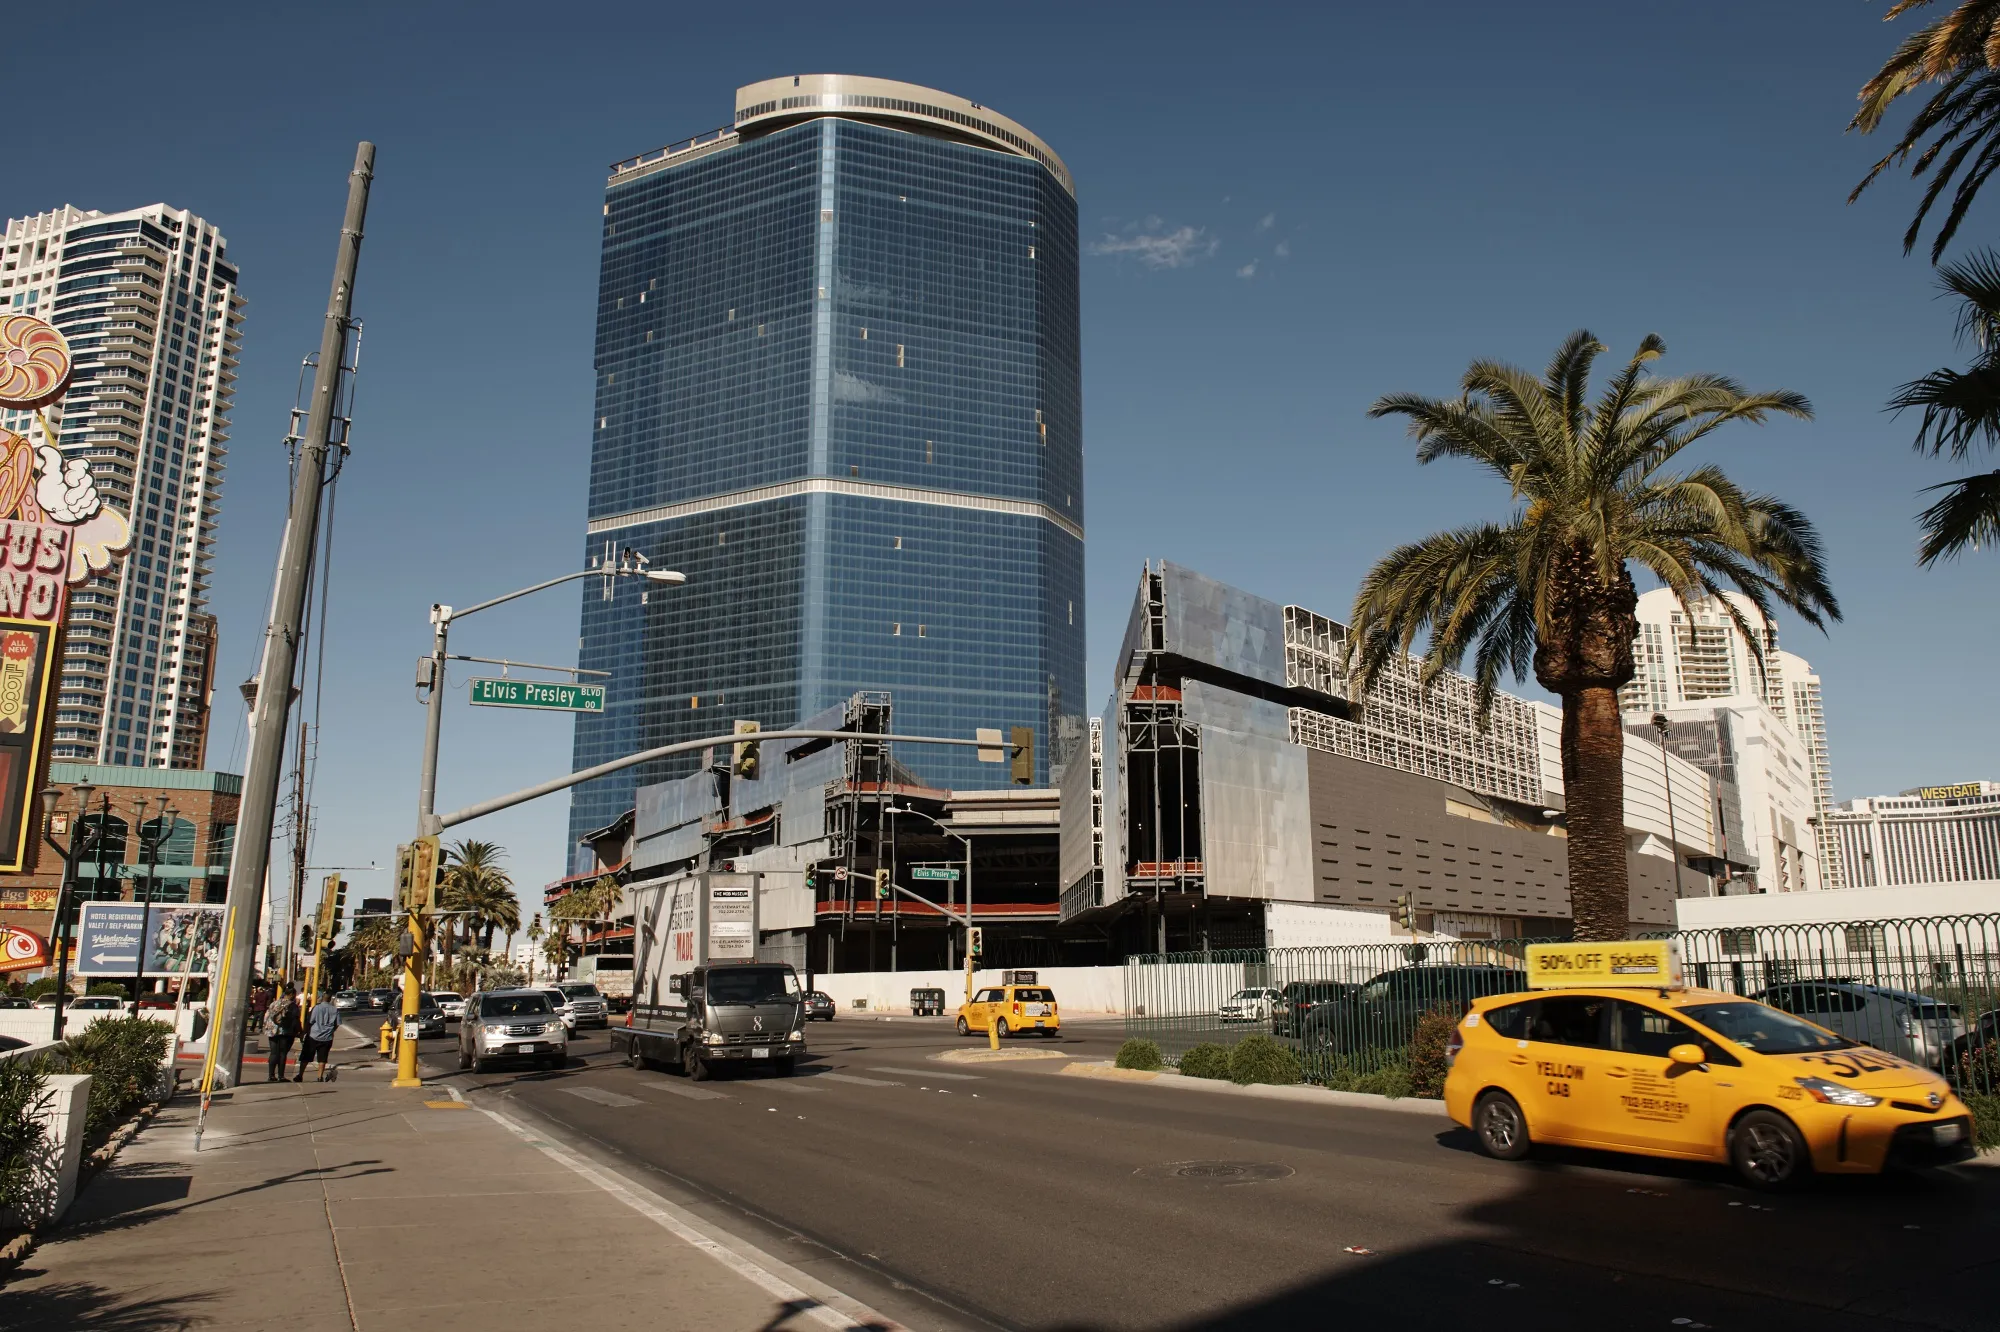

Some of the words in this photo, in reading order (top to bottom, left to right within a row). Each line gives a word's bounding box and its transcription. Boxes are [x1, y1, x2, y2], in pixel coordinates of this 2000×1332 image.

[474, 680, 480, 689] E
[483, 681, 517, 699] Elvis
[525, 684, 575, 707] Presley
[581, 687, 601, 697] BLVD
[1920, 783, 1981, 800] WESTGATE
[917, 869, 930, 877] Elvis
[931, 869, 949, 878] Presley
[108, 913, 144, 921] REGISTRATIO
[683, 910, 694, 929] TRIP
[109, 922, 143, 930] SELF-PARKIN
[676, 931, 694, 961] MADE
[1540, 955, 1573, 970] 50%
[1575, 953, 1603, 969] OFF
[1609, 953, 1658, 966] tickets
[1536, 1061, 1585, 1080] YELLOW
[1546, 1081, 1570, 1097] CAB
